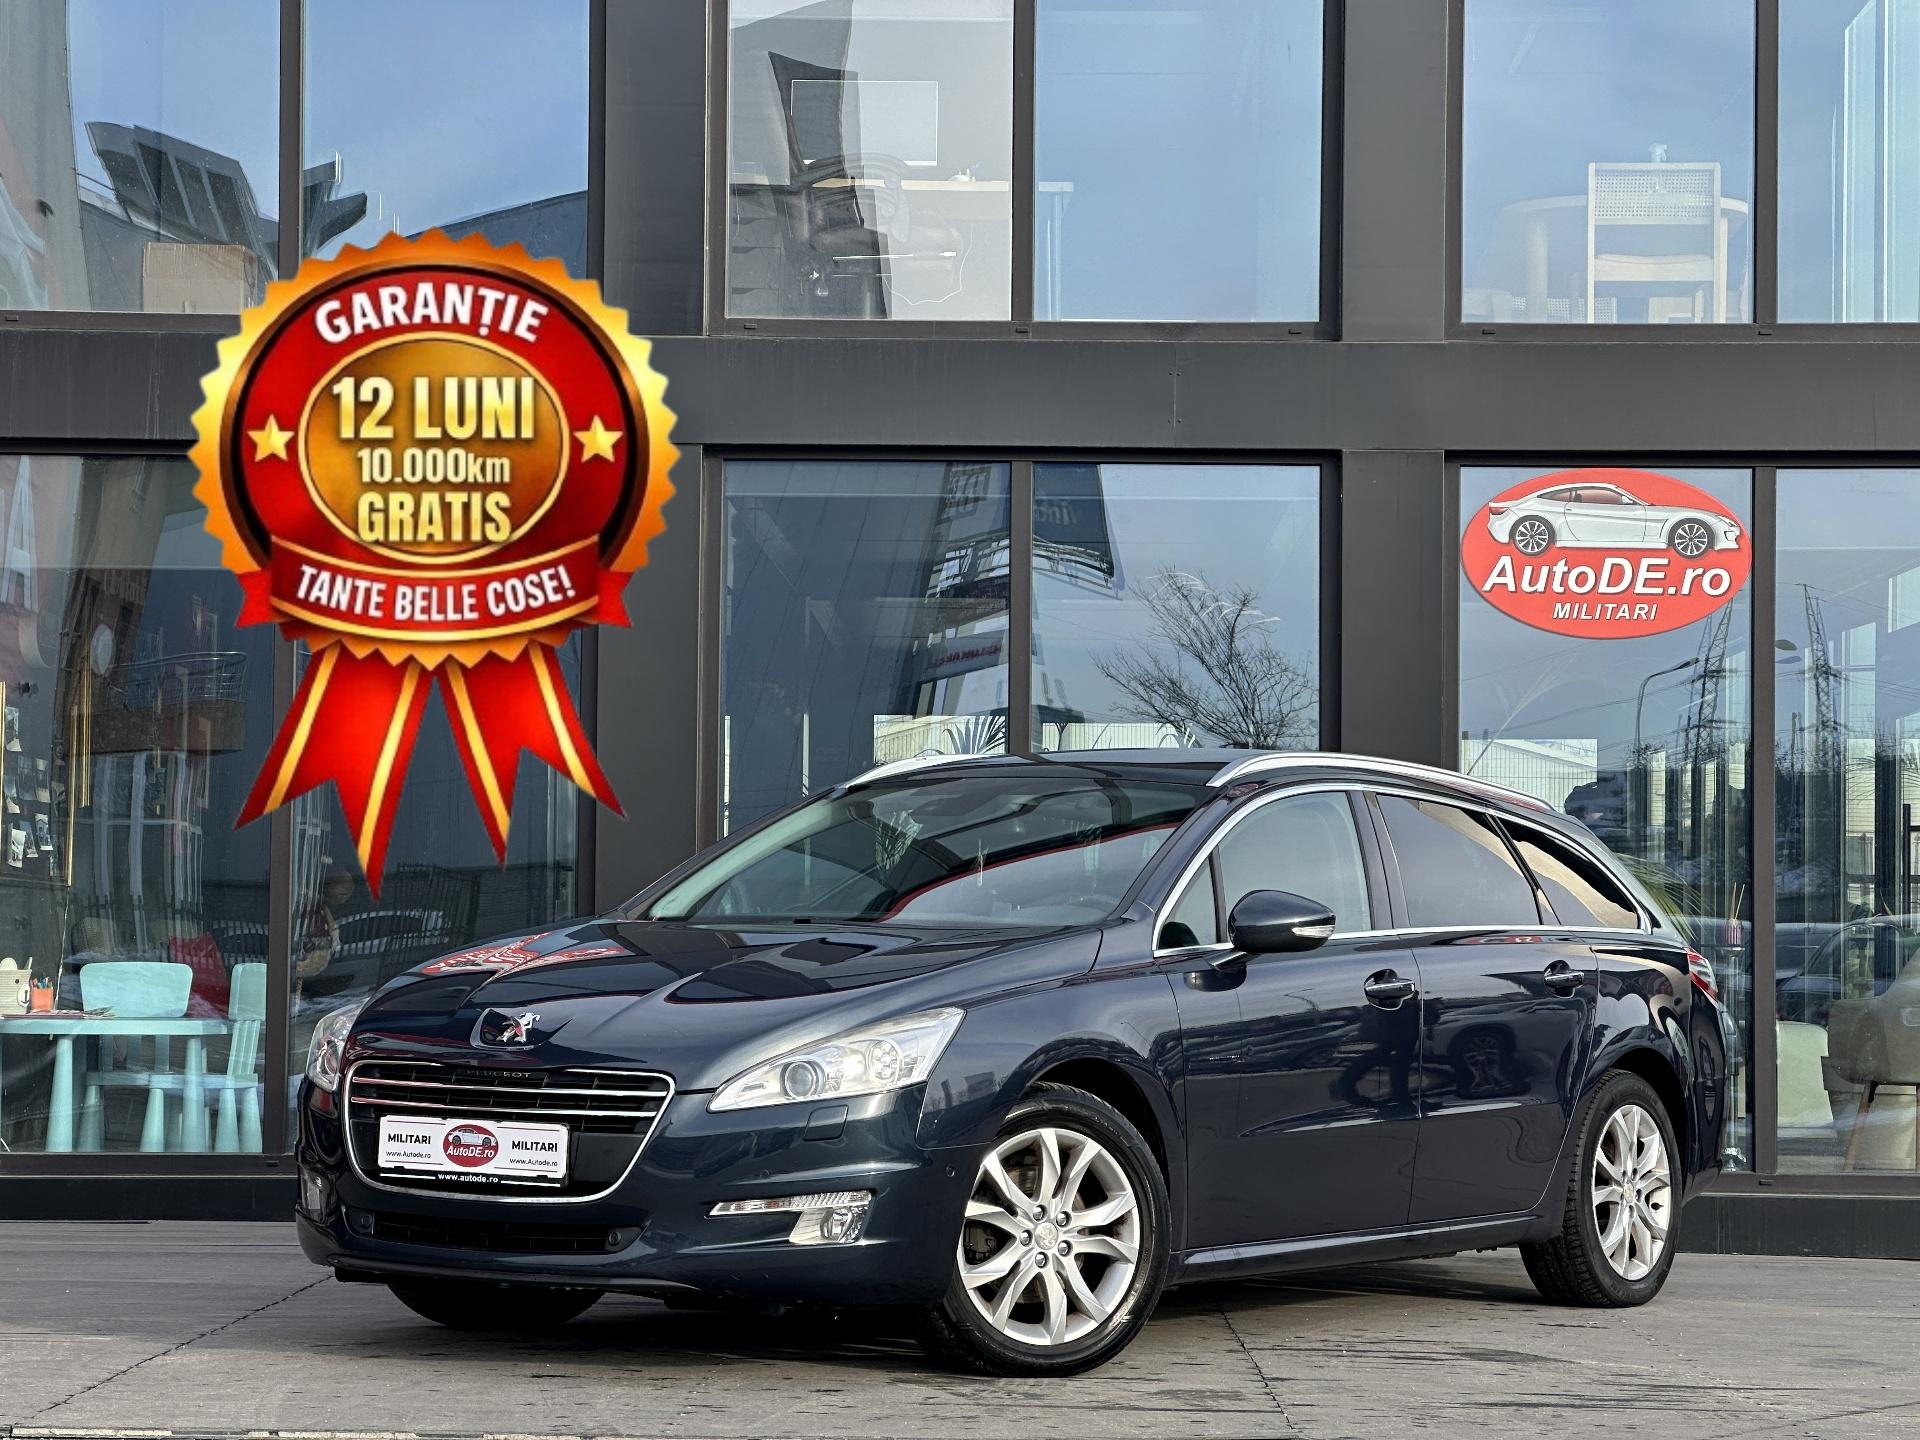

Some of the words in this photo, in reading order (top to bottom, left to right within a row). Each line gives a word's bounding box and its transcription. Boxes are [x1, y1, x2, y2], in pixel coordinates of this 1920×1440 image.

[1482, 555, 1731, 596] AutoDE.ro
[1552, 603, 1658, 621] MILITARI
[387, 1133, 431, 1145] MILITARI
[446, 1145, 495, 1159] AutoDE.ro
[511, 1140, 558, 1153] MILITARI
[509, 1158, 558, 1167] www.Autode.ro
[437, 1172, 499, 1184] www.autode.ro
